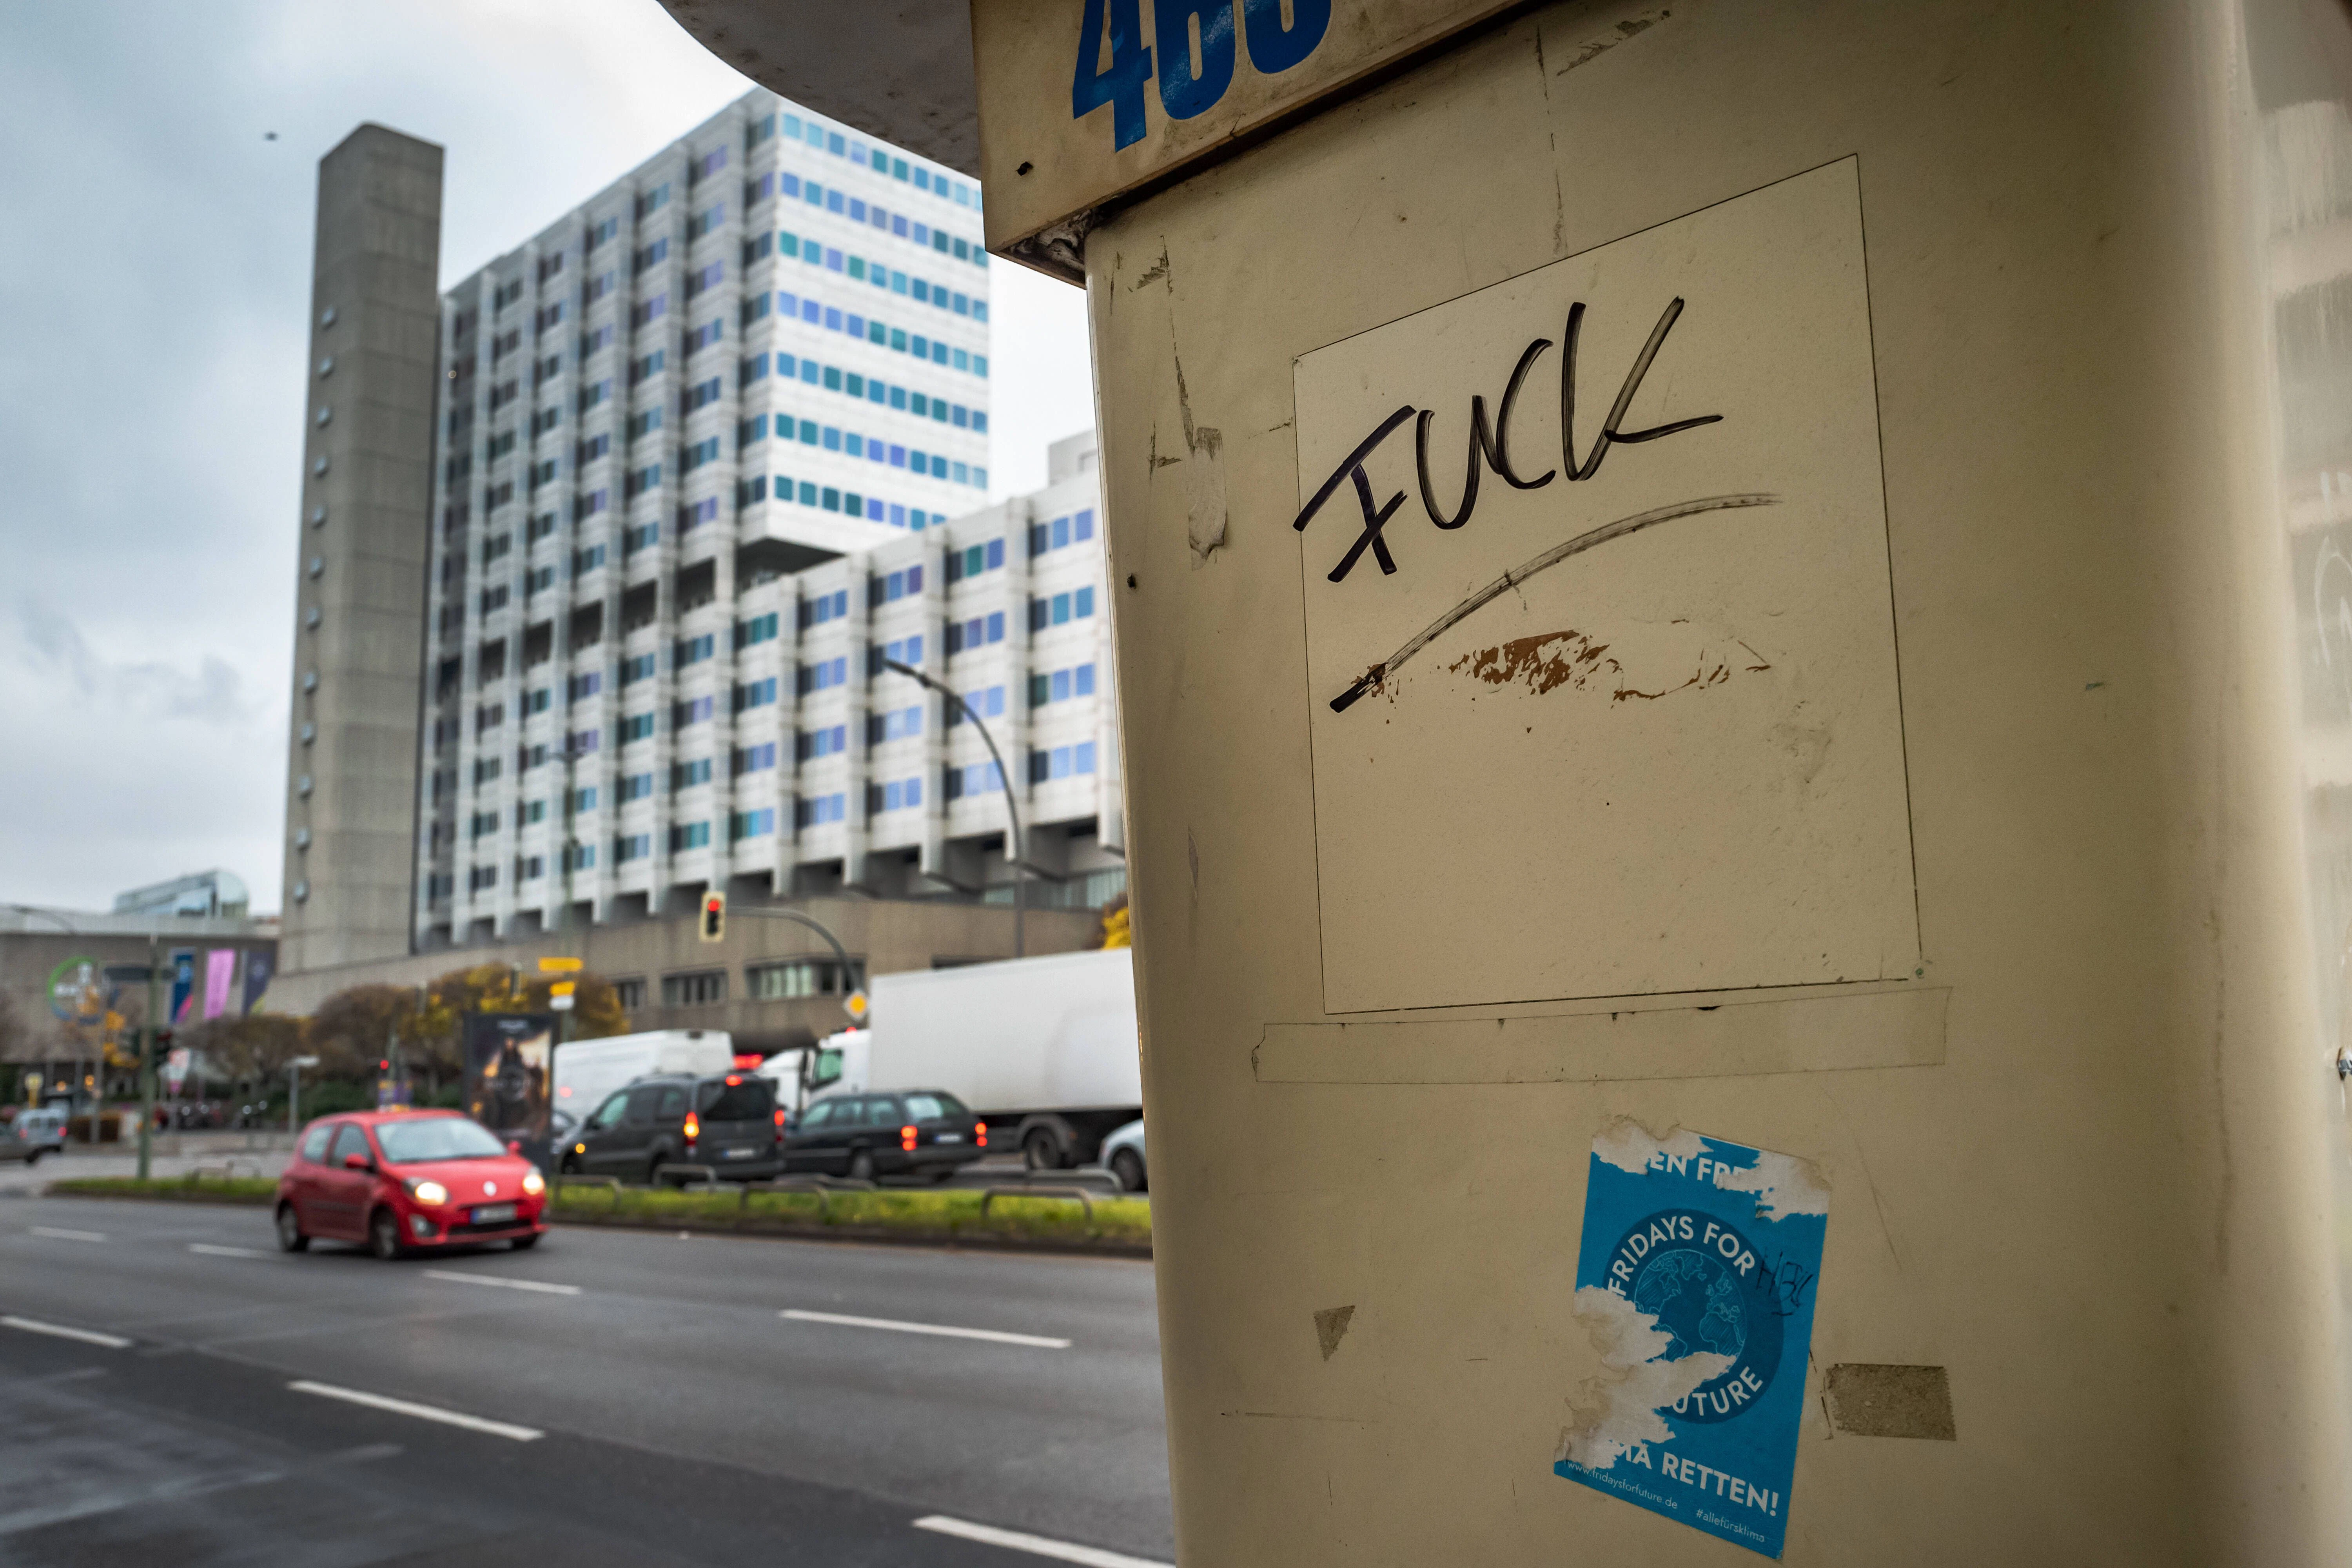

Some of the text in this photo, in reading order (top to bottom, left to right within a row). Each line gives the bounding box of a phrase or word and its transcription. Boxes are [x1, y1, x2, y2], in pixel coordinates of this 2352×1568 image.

[1292, 295, 1724, 583] FUCK
[1608, 1216, 1755, 1297] FRIDAYS FOR
[1672, 1366, 1763, 1416] UTURE
[1662, 1452, 1779, 1516] RETTEN!
